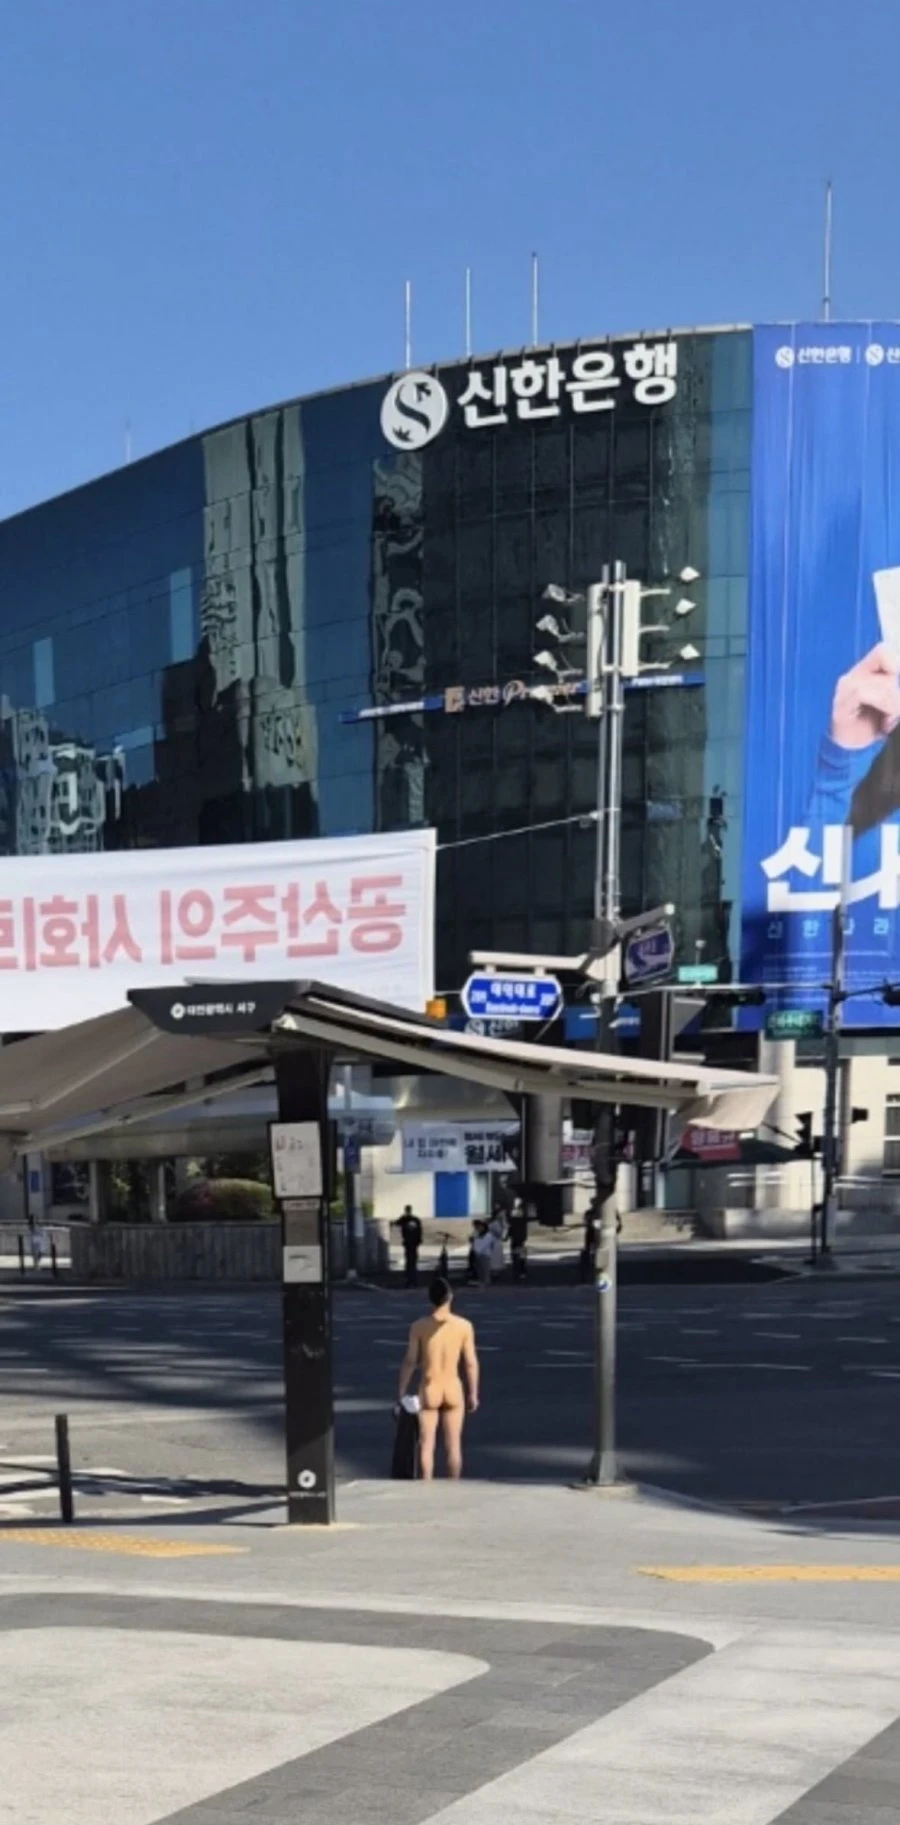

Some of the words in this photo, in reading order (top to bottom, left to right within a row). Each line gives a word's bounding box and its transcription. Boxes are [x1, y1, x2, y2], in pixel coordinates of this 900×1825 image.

[797, 345, 852, 364] 신한은행
[456, 341, 679, 429] 신한은행
[490, 983, 537, 999] 대덕대로
[187, 1003, 234, 1016] 대전광역시
[236, 1001, 256, 1014] 서구
